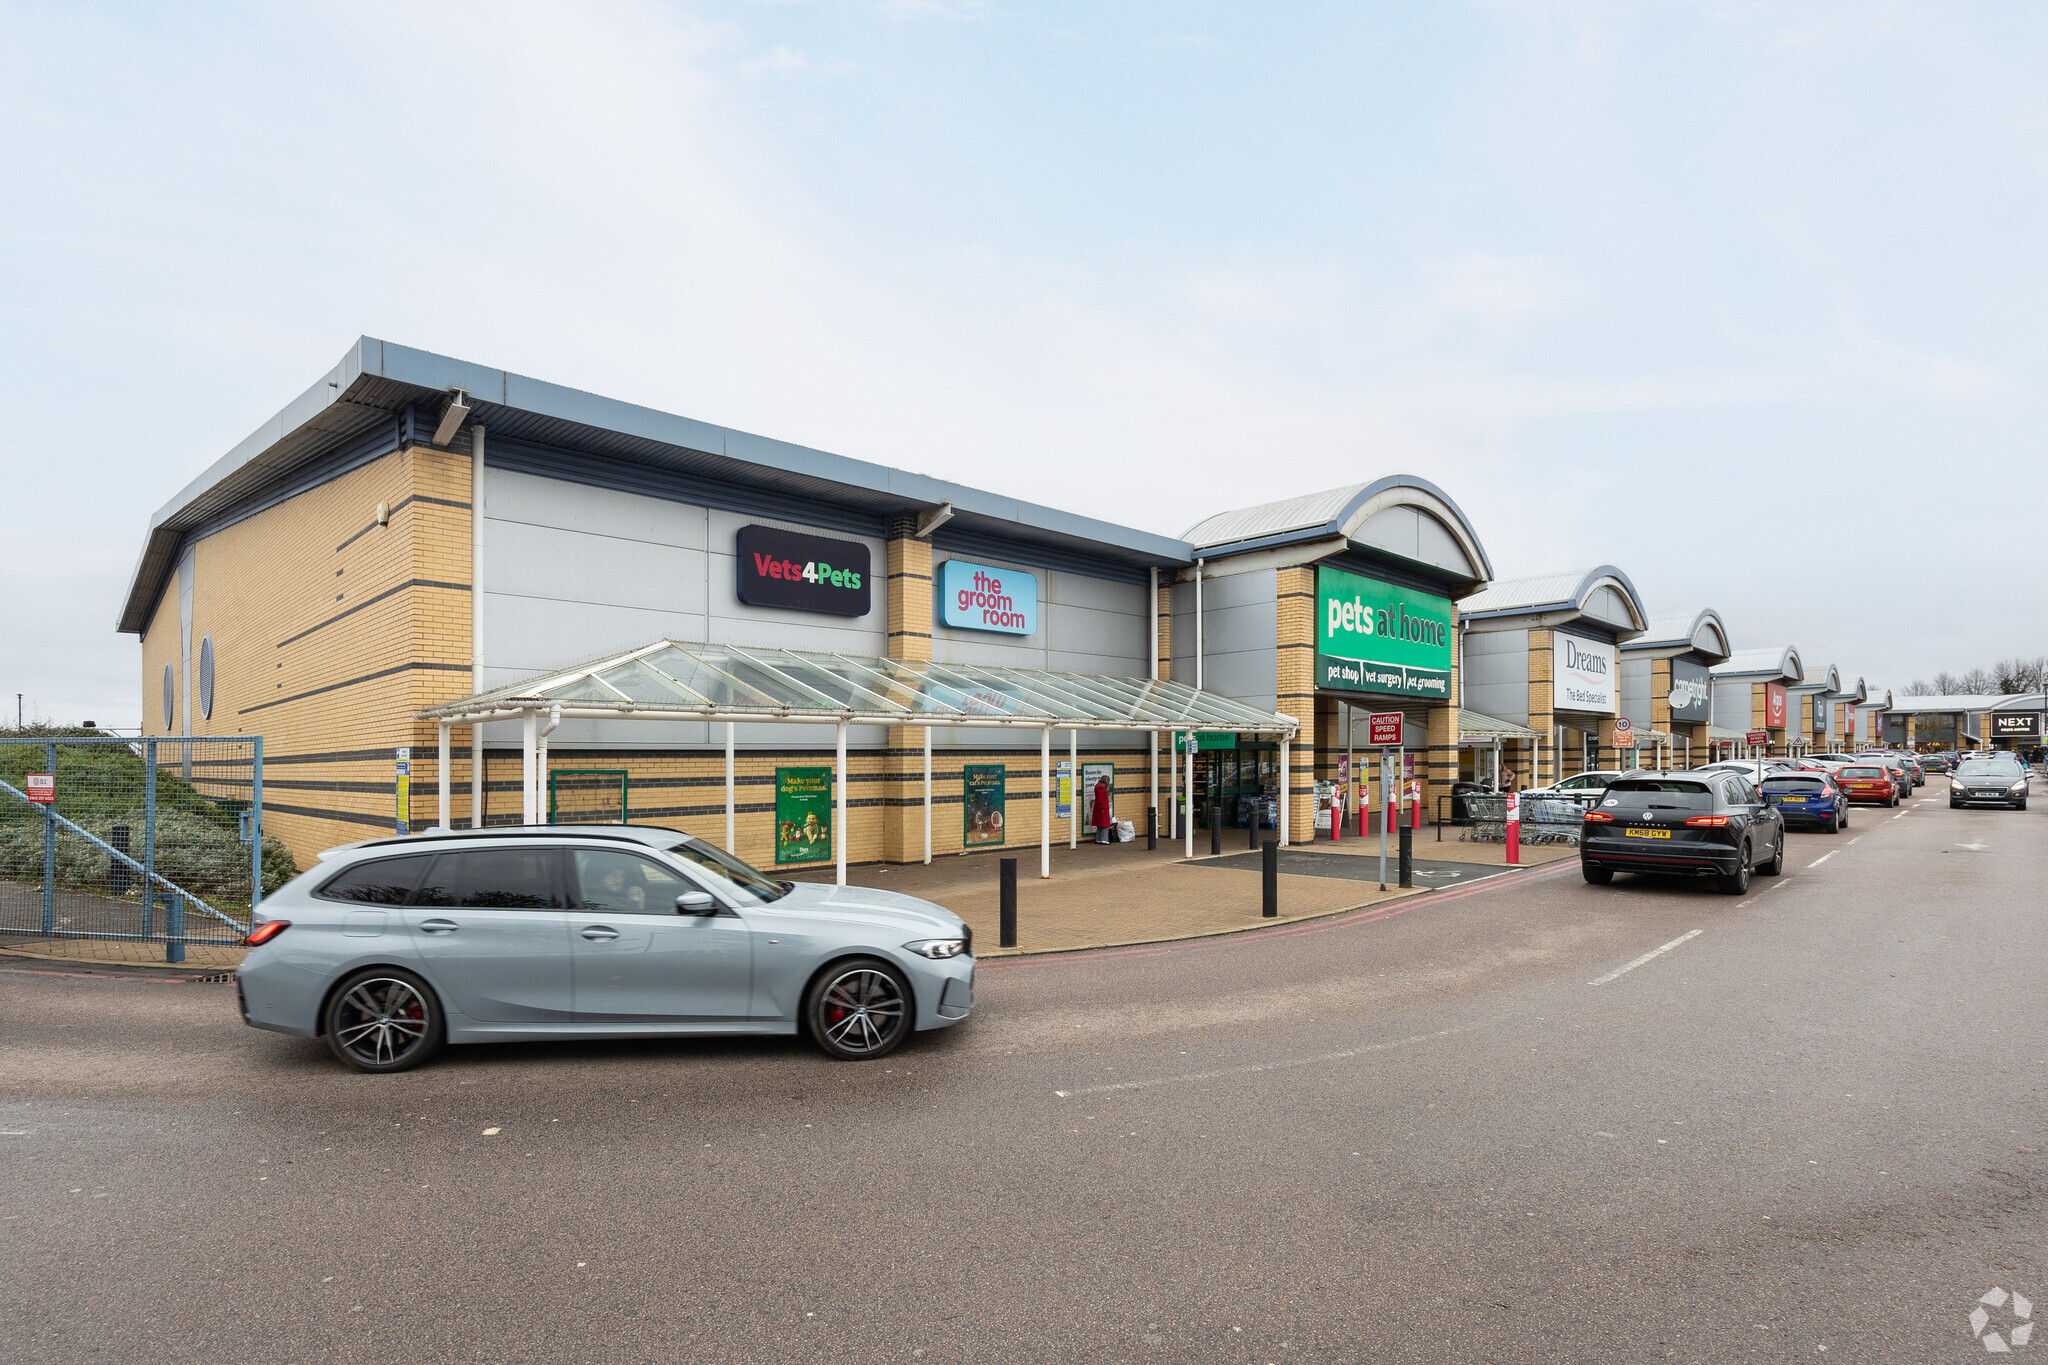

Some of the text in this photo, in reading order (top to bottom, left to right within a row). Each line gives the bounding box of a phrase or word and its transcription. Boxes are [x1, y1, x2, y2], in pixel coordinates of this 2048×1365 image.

[753, 552, 861, 590] Vets4Pets
[973, 571, 1001, 594] the
[958, 589, 1012, 611] groom
[983, 609, 1025, 629] room
[1328, 596, 1445, 648] pets at home
[1566, 640, 1606, 674] Dreams
[1328, 666, 1445, 692] pet shop vet surgery pet grooming
[1566, 688, 1606, 705] The Bed Specialist
[1773, 690, 1782, 710] Argos
[1371, 716, 1400, 724] CAUTION
[1998, 717, 2033, 727] NEXT
[1207, 732, 1230, 741] home
[780, 785, 798, 793] dog's
